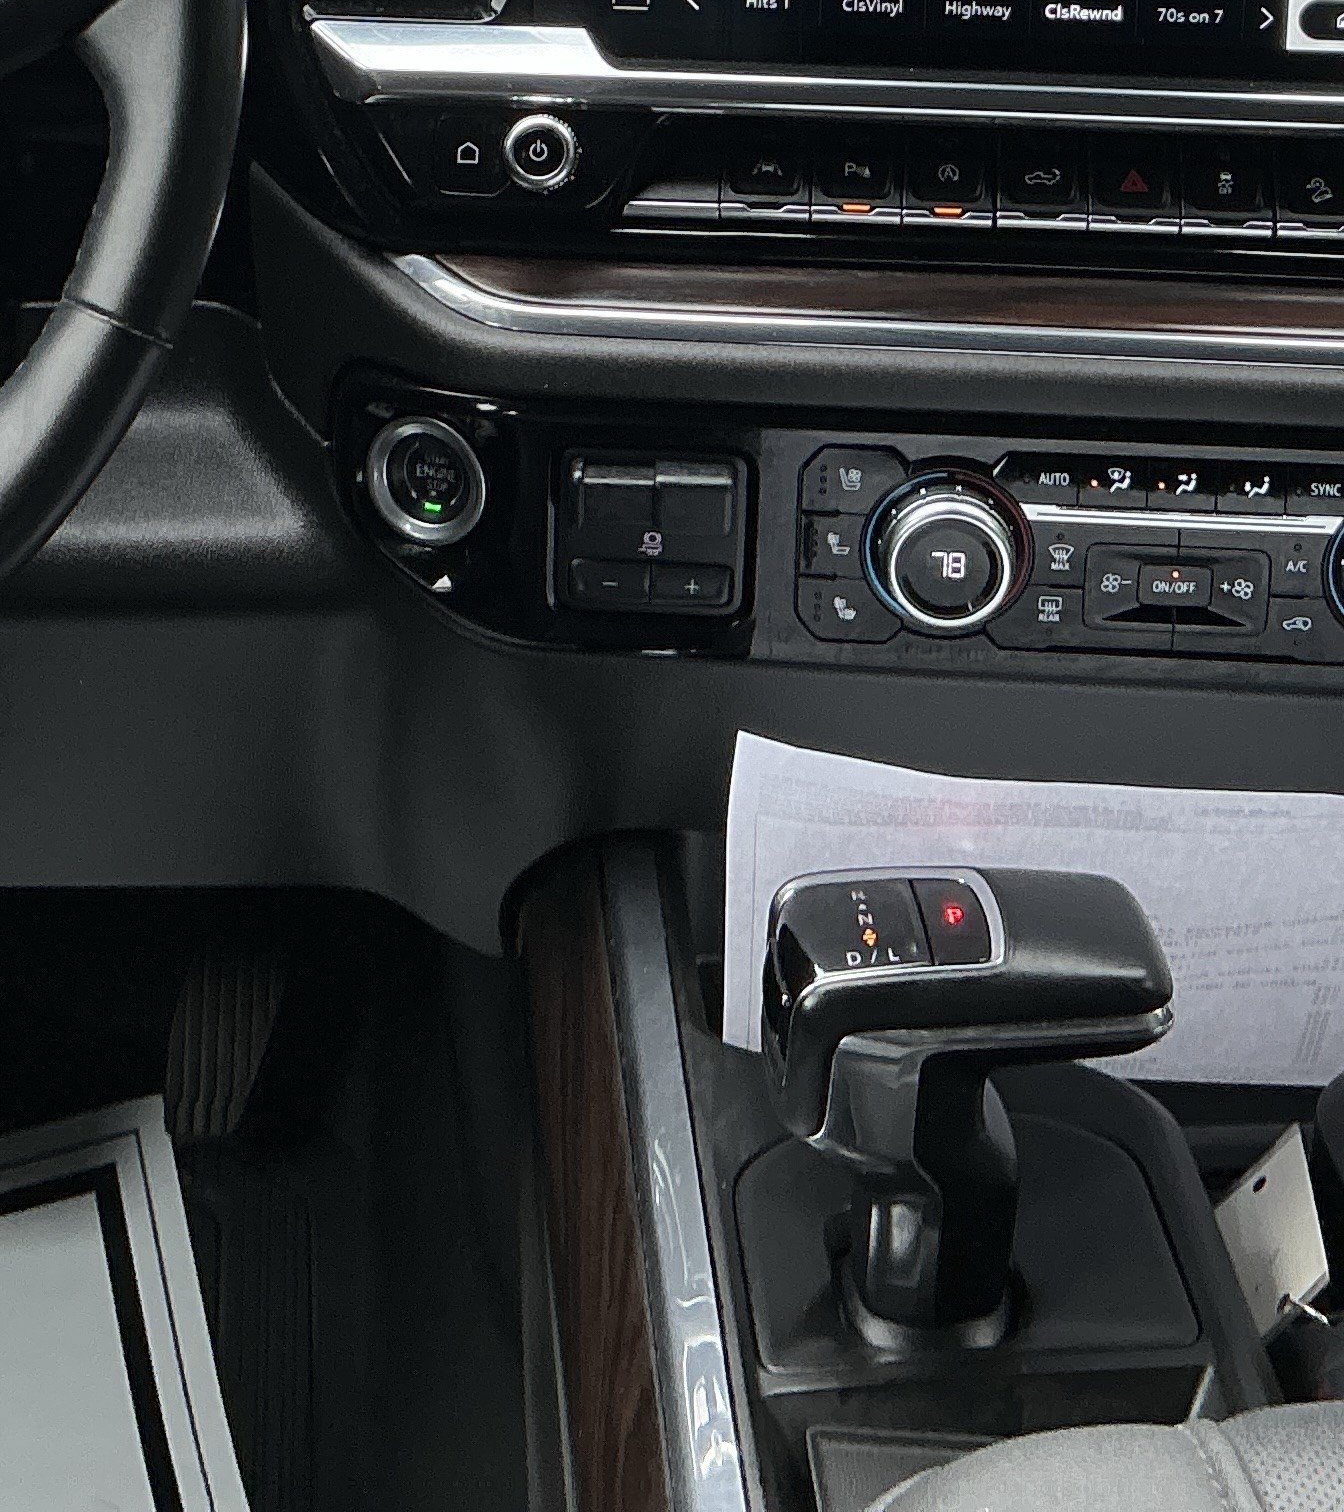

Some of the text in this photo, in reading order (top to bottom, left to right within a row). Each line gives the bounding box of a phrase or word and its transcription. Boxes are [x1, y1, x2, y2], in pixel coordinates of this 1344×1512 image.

[945, 1, 1011, 21] Highway
[1045, 3, 1122, 22] ClsRewnd
[1157, 8, 1224, 24] 70s on 7
[1038, 472, 1069, 486] AUTO
[1310, 483, 1341, 497] SYNC
[931, 551, 965, 579] 78
[1286, 560, 1307, 573] A/C
[1152, 580, 1196, 594] ON/OFF
[858, 913, 873, 926] N
[945, 906, 964, 925] P
[846, 950, 862, 966] D
[887, 947, 901, 963] L
